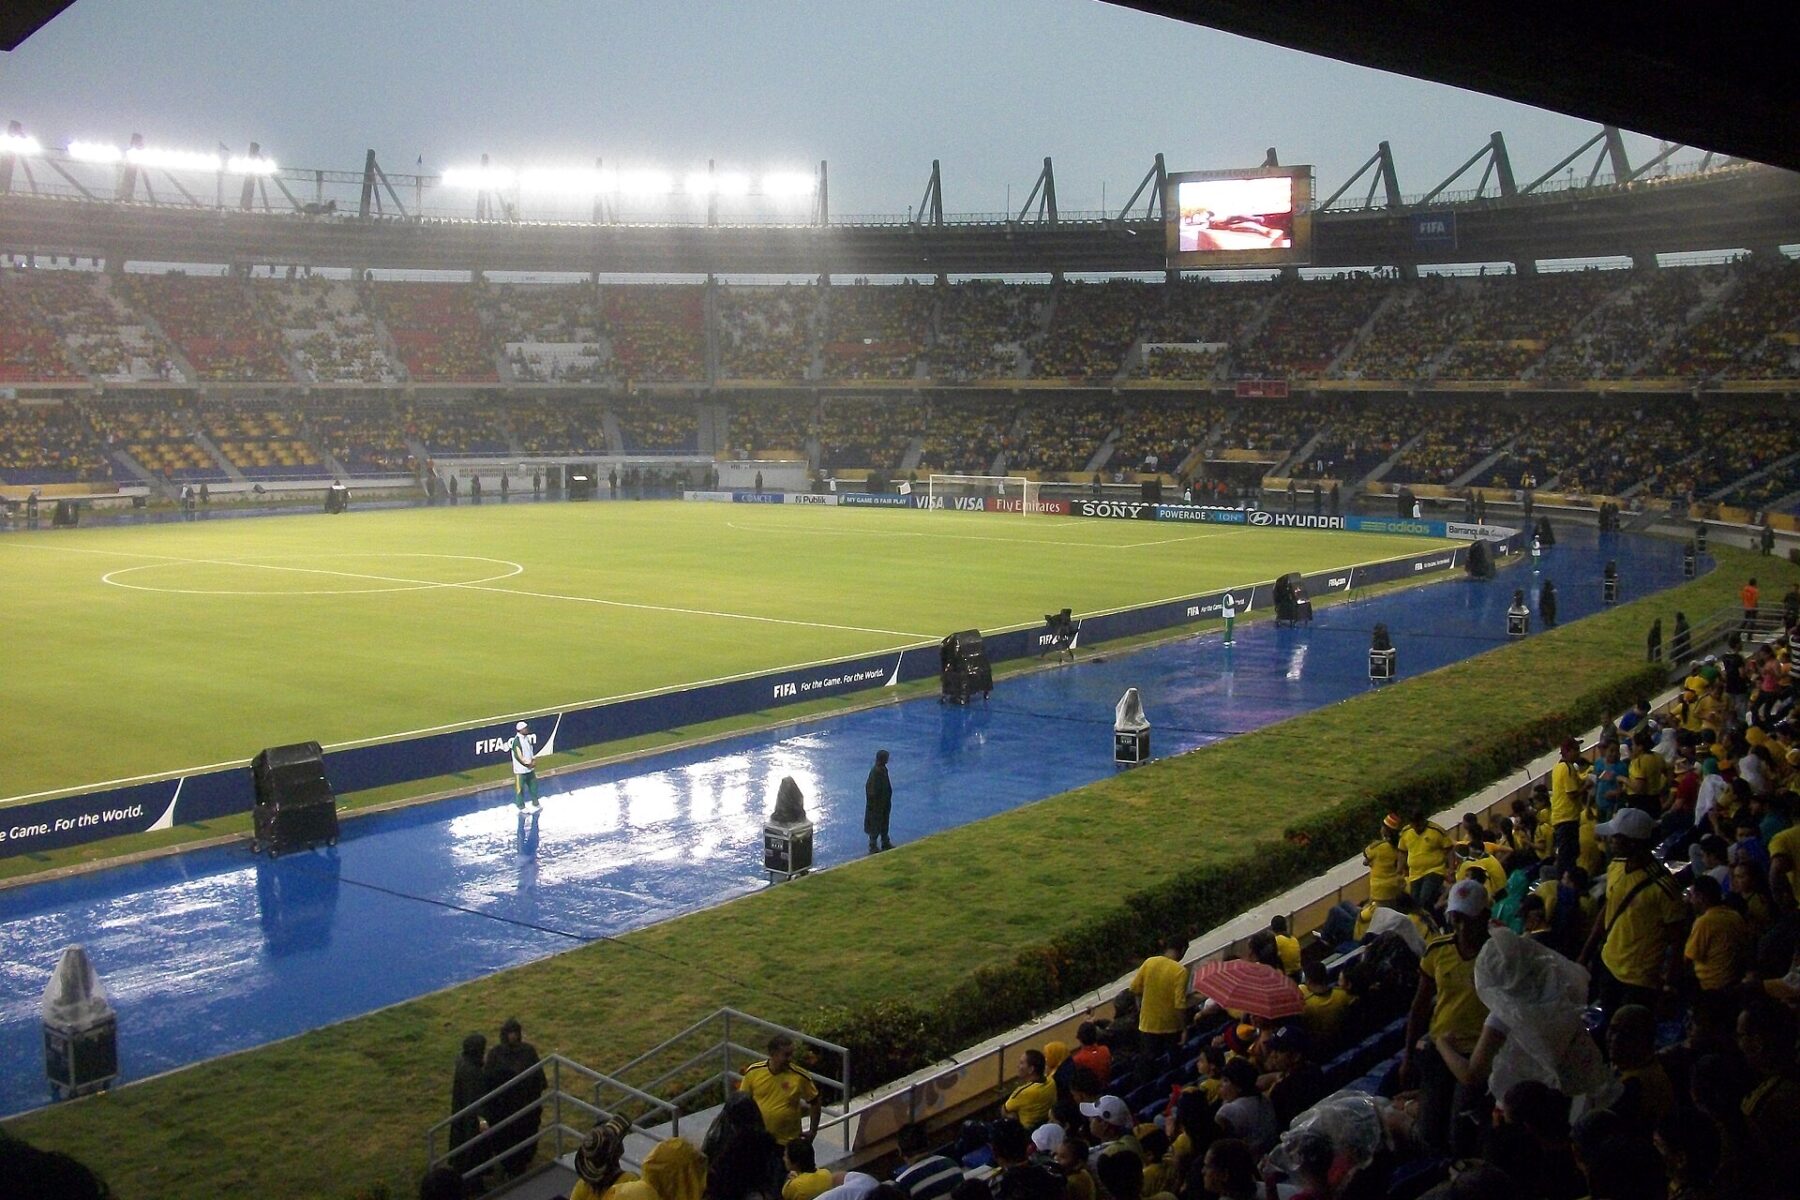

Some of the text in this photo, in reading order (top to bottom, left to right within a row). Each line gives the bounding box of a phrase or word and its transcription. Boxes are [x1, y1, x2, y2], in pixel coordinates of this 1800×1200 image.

[1420, 221, 1445, 233] FIFA
[803, 495, 826, 504] Publik
[915, 495, 945, 509] VISA
[954, 497, 984, 511] VISA
[997, 499, 1061, 513] Fly Emirates
[1082, 503, 1142, 518] SONY
[1160, 510, 1206, 520] POWERADE
[1275, 514, 1345, 529] HYUNDAI
[1387, 520, 1430, 534] adidas
[1187, 606, 1200, 617] FIFA
[773, 668, 884, 698] FIFA For the Game. For the World.
[9, 823, 52, 840] Game.
[54, 816, 77, 831] For
[78, 813, 100, 827] the
[102, 803, 144, 821] World.
